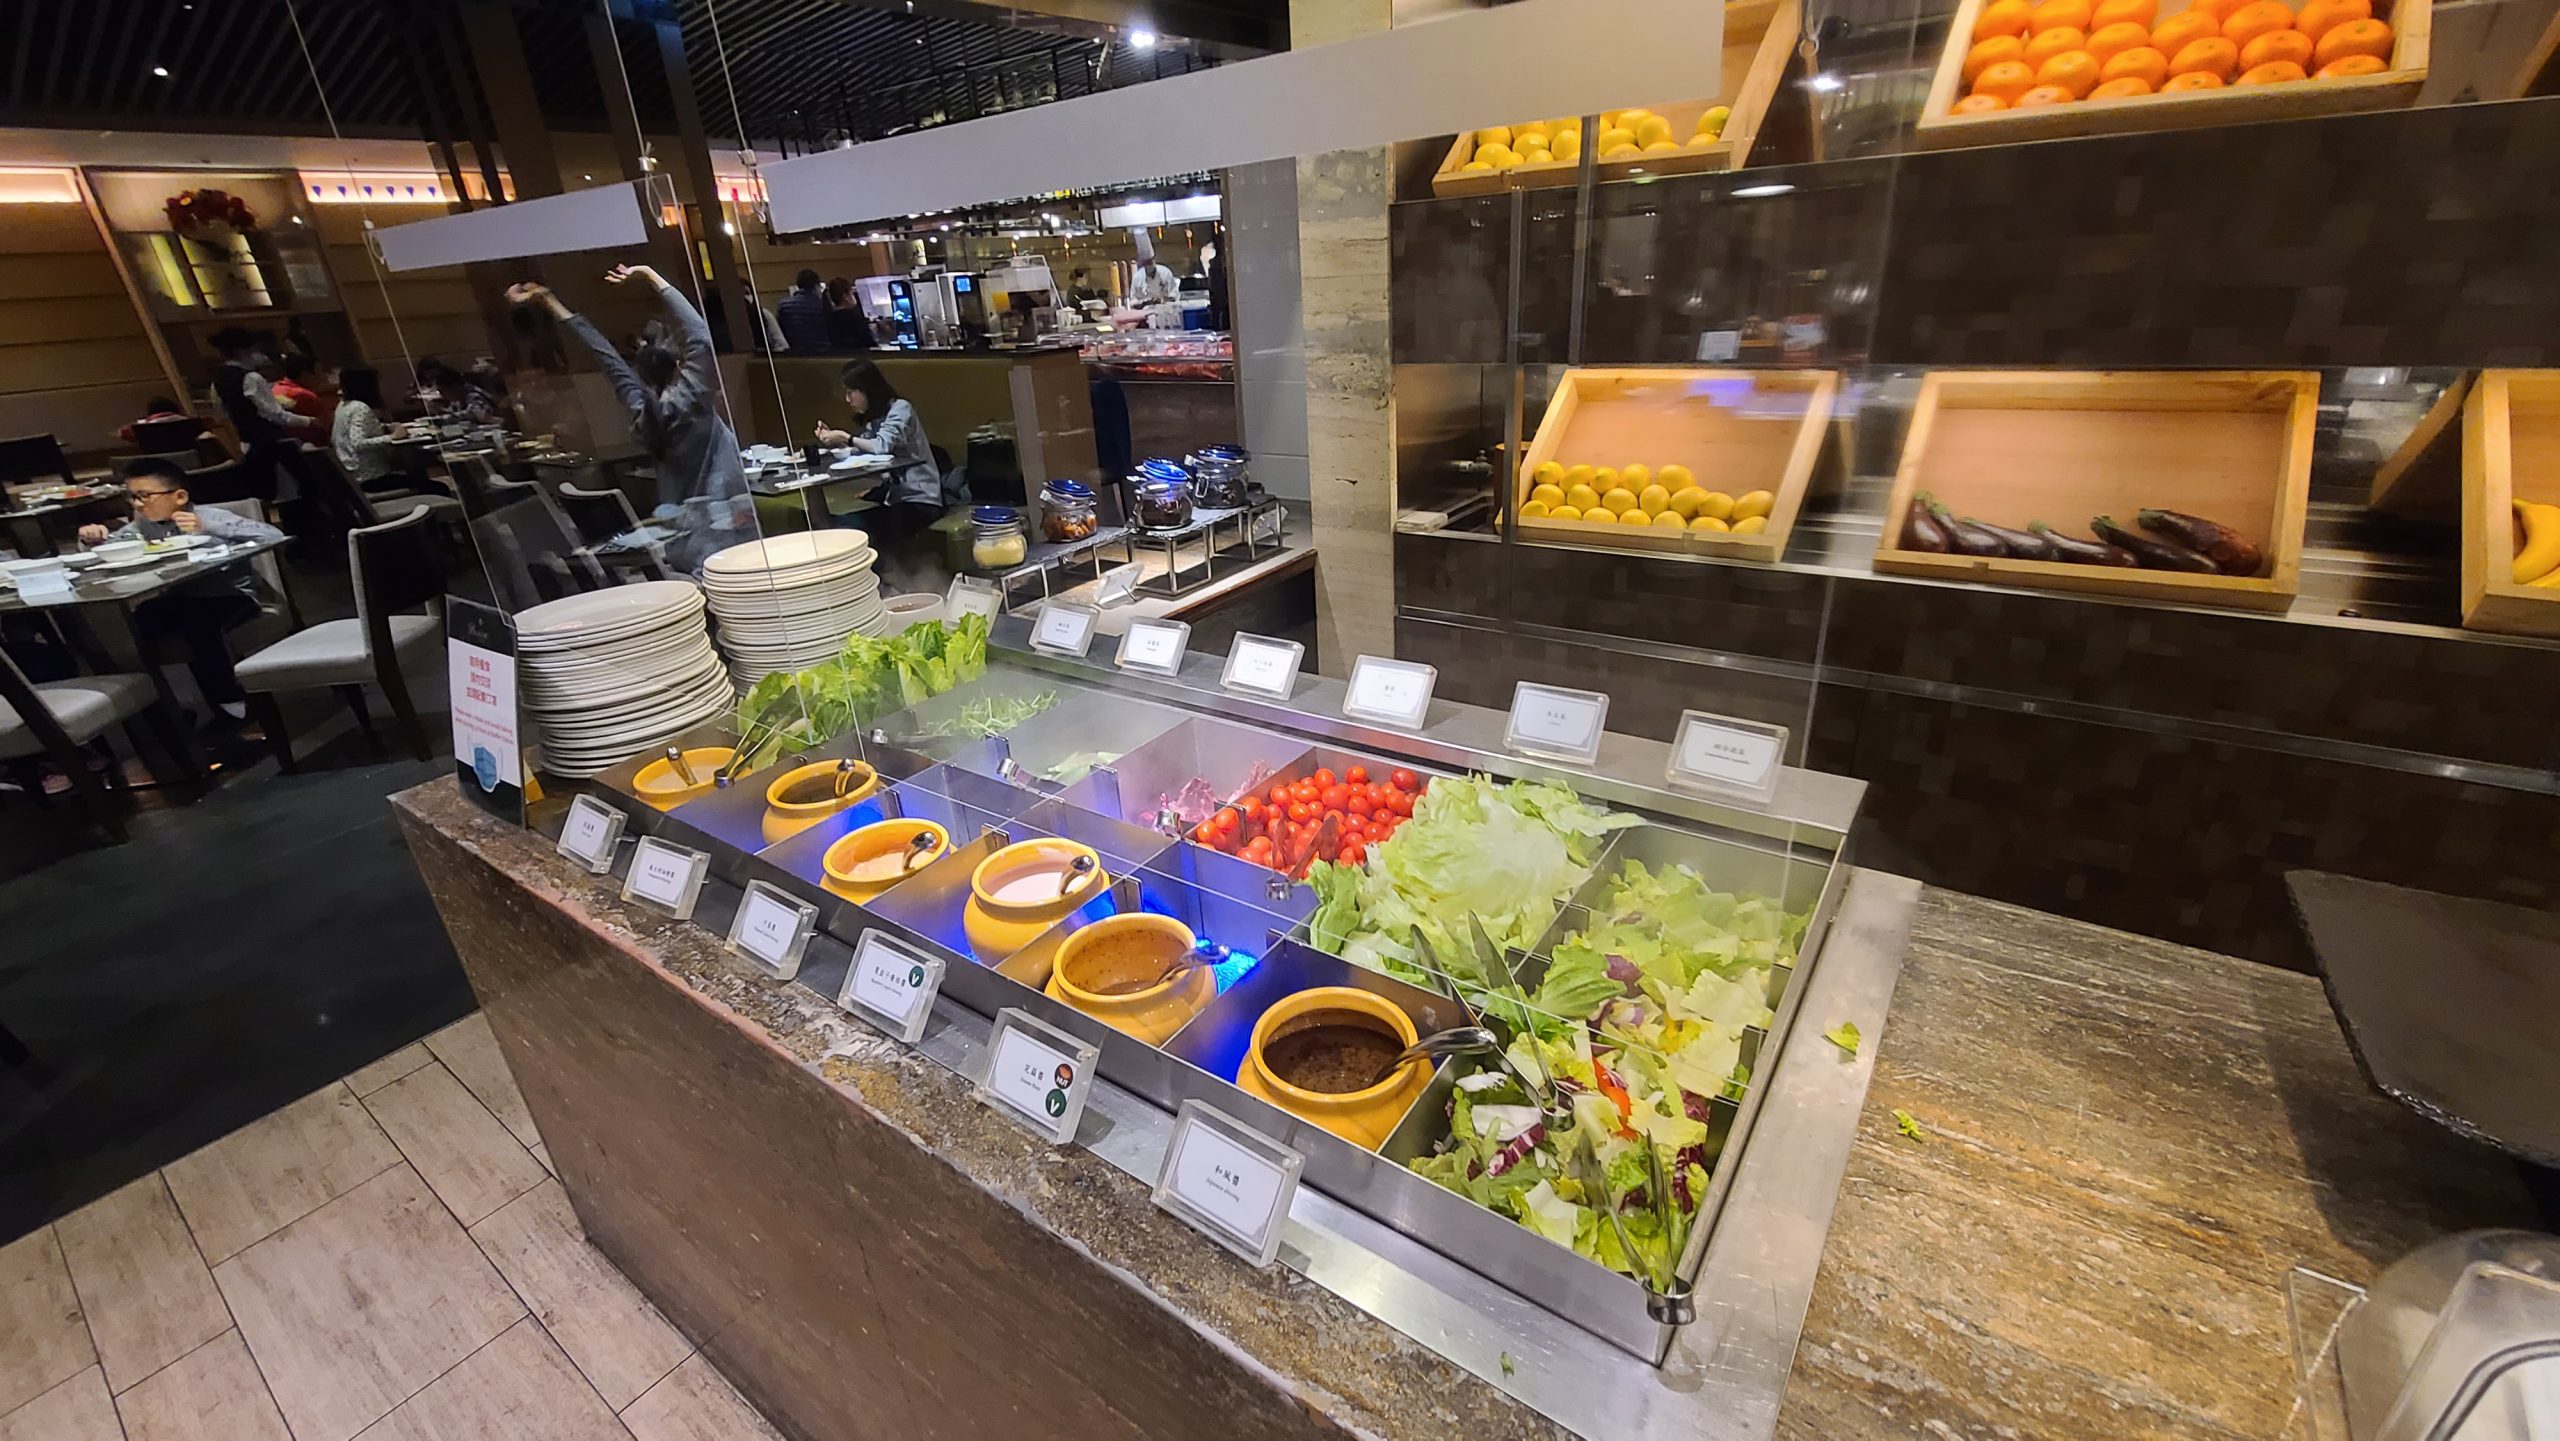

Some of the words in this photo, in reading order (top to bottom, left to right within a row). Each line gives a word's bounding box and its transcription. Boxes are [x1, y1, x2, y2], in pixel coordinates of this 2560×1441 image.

[911, 973, 919, 985] V
[1056, 1076, 1069, 1087] NUT
[1050, 1098, 1060, 1114] V
